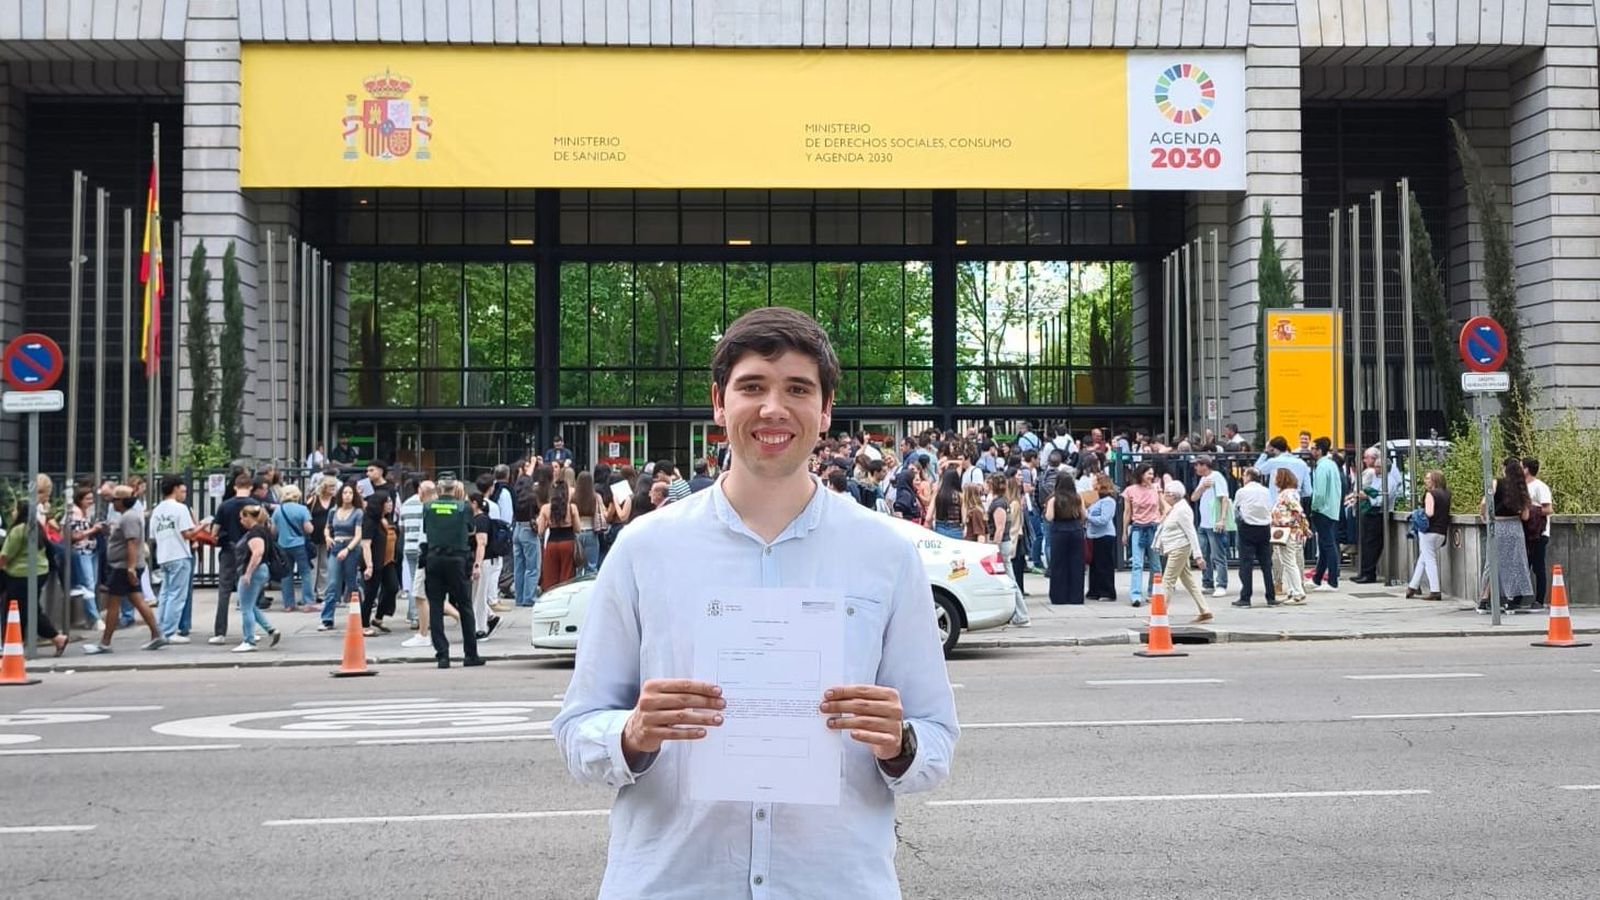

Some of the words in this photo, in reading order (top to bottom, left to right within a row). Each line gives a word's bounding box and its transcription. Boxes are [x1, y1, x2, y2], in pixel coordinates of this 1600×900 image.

[805, 124, 871, 133] MINISTERIO
[553, 136, 620, 146] MINISTERIO
[1150, 132, 1221, 144] AGENDA
[805, 138, 821, 148] DE
[824, 138, 887, 148] DERECHOS
[890, 138, 947, 149] SOCIALES,
[949, 138, 1012, 148] CONSUMO
[553, 151, 569, 161] DE
[572, 151, 626, 161] SANIDAD
[805, 153, 812, 162] Y
[814, 153, 864, 162] AGENDA
[867, 153, 893, 162] 2030
[1151, 148, 1221, 168] 2030
